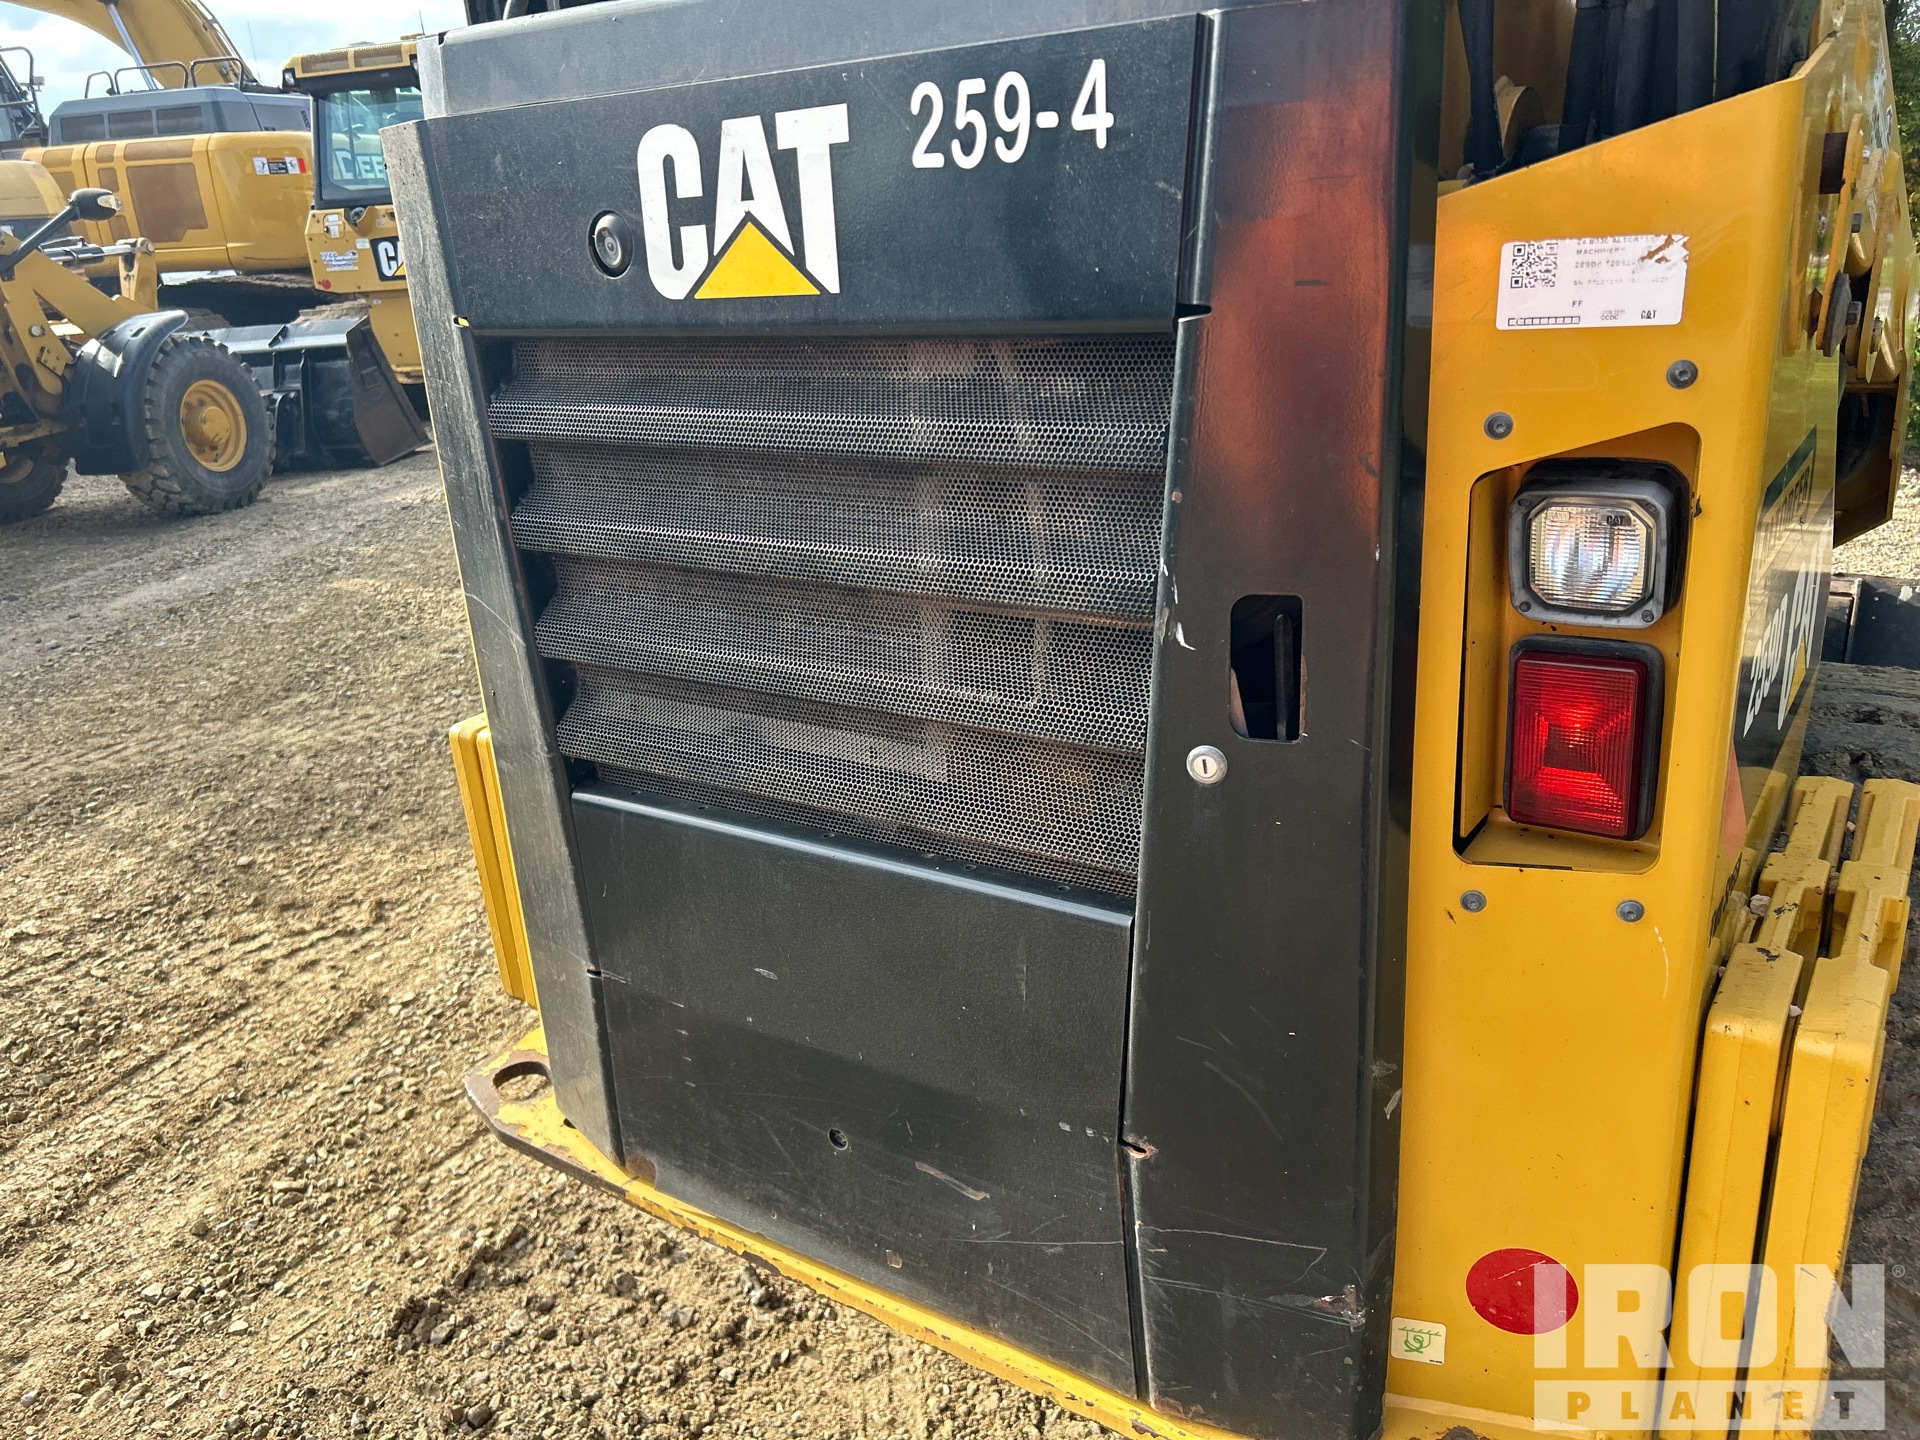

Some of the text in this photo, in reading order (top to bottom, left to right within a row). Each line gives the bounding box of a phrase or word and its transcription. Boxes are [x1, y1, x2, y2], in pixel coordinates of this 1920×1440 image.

[910, 58, 1115, 170] 259-4
[637, 103, 849, 300] CAT
[1640, 310, 1657, 319] CAT
[1607, 515, 1625, 526] CAT
[1777, 516, 1832, 731] CAT
